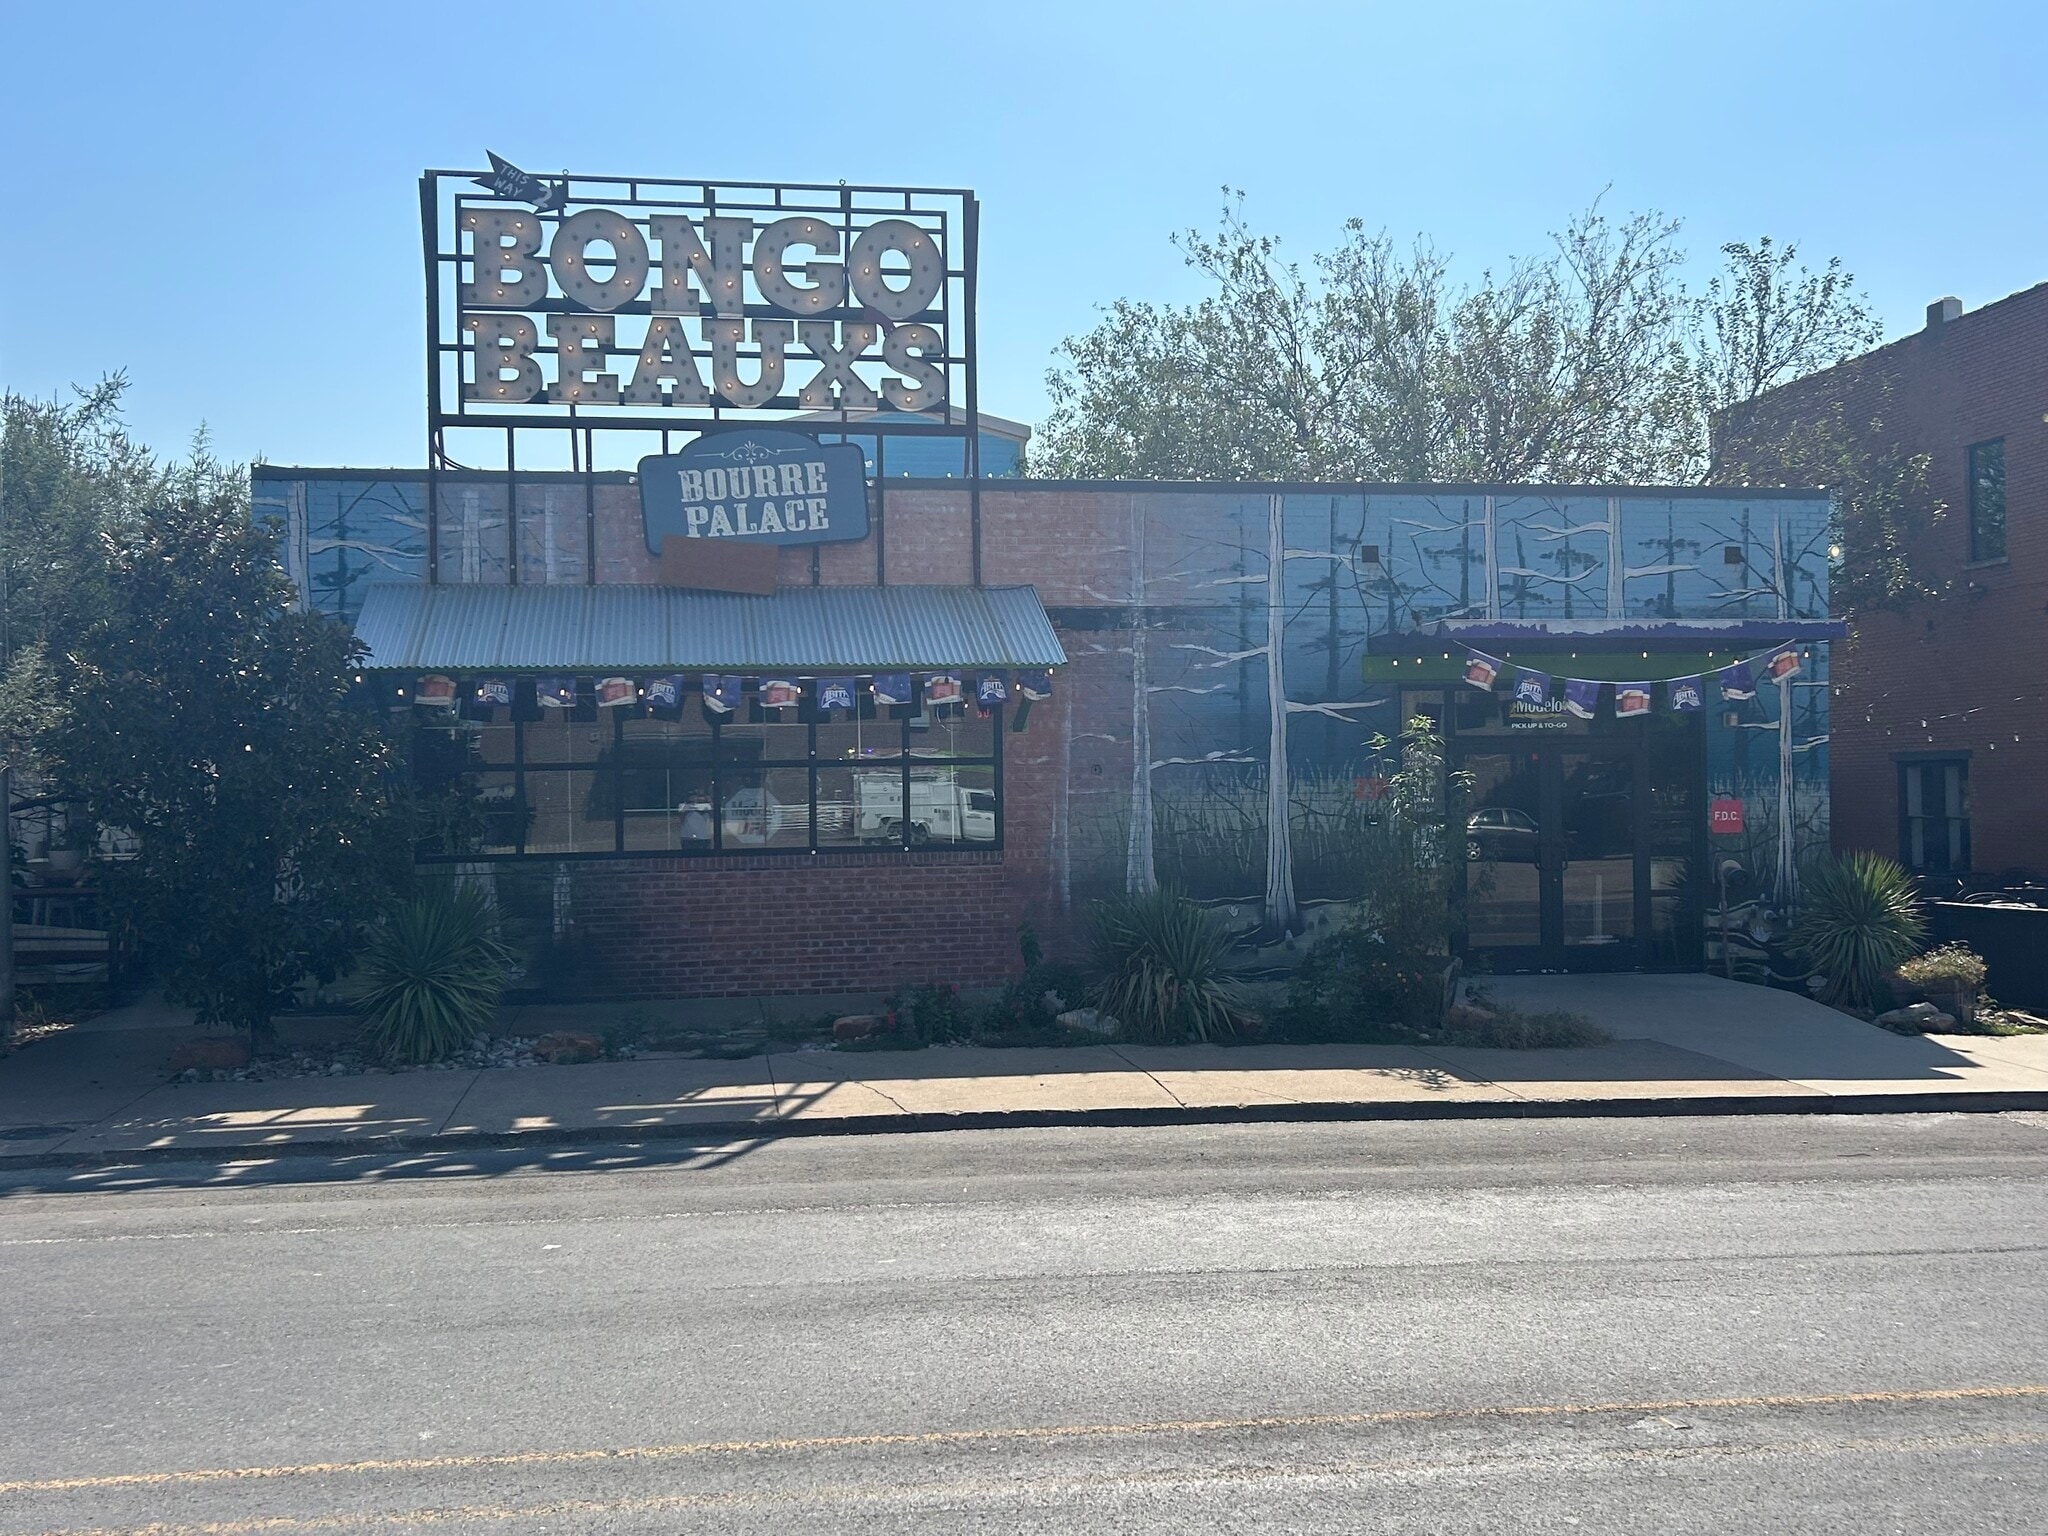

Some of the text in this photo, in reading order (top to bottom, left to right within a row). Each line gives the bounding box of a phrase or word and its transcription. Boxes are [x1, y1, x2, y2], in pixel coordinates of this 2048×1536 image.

[501, 163, 530, 185] THIS
[493, 177, 523, 197] WAY
[532, 186, 552, 208] 2
[461, 208, 942, 320] BONGO
[463, 313, 946, 410] BEAUXS
[678, 462, 828, 502] BOURRE
[684, 498, 829, 538] PALACE
[646, 682, 675, 697] ABITA
[821, 689, 850, 704] ABITA
[980, 681, 1005, 696] ABITA
[1714, 811, 1740, 821] F.D.C.
